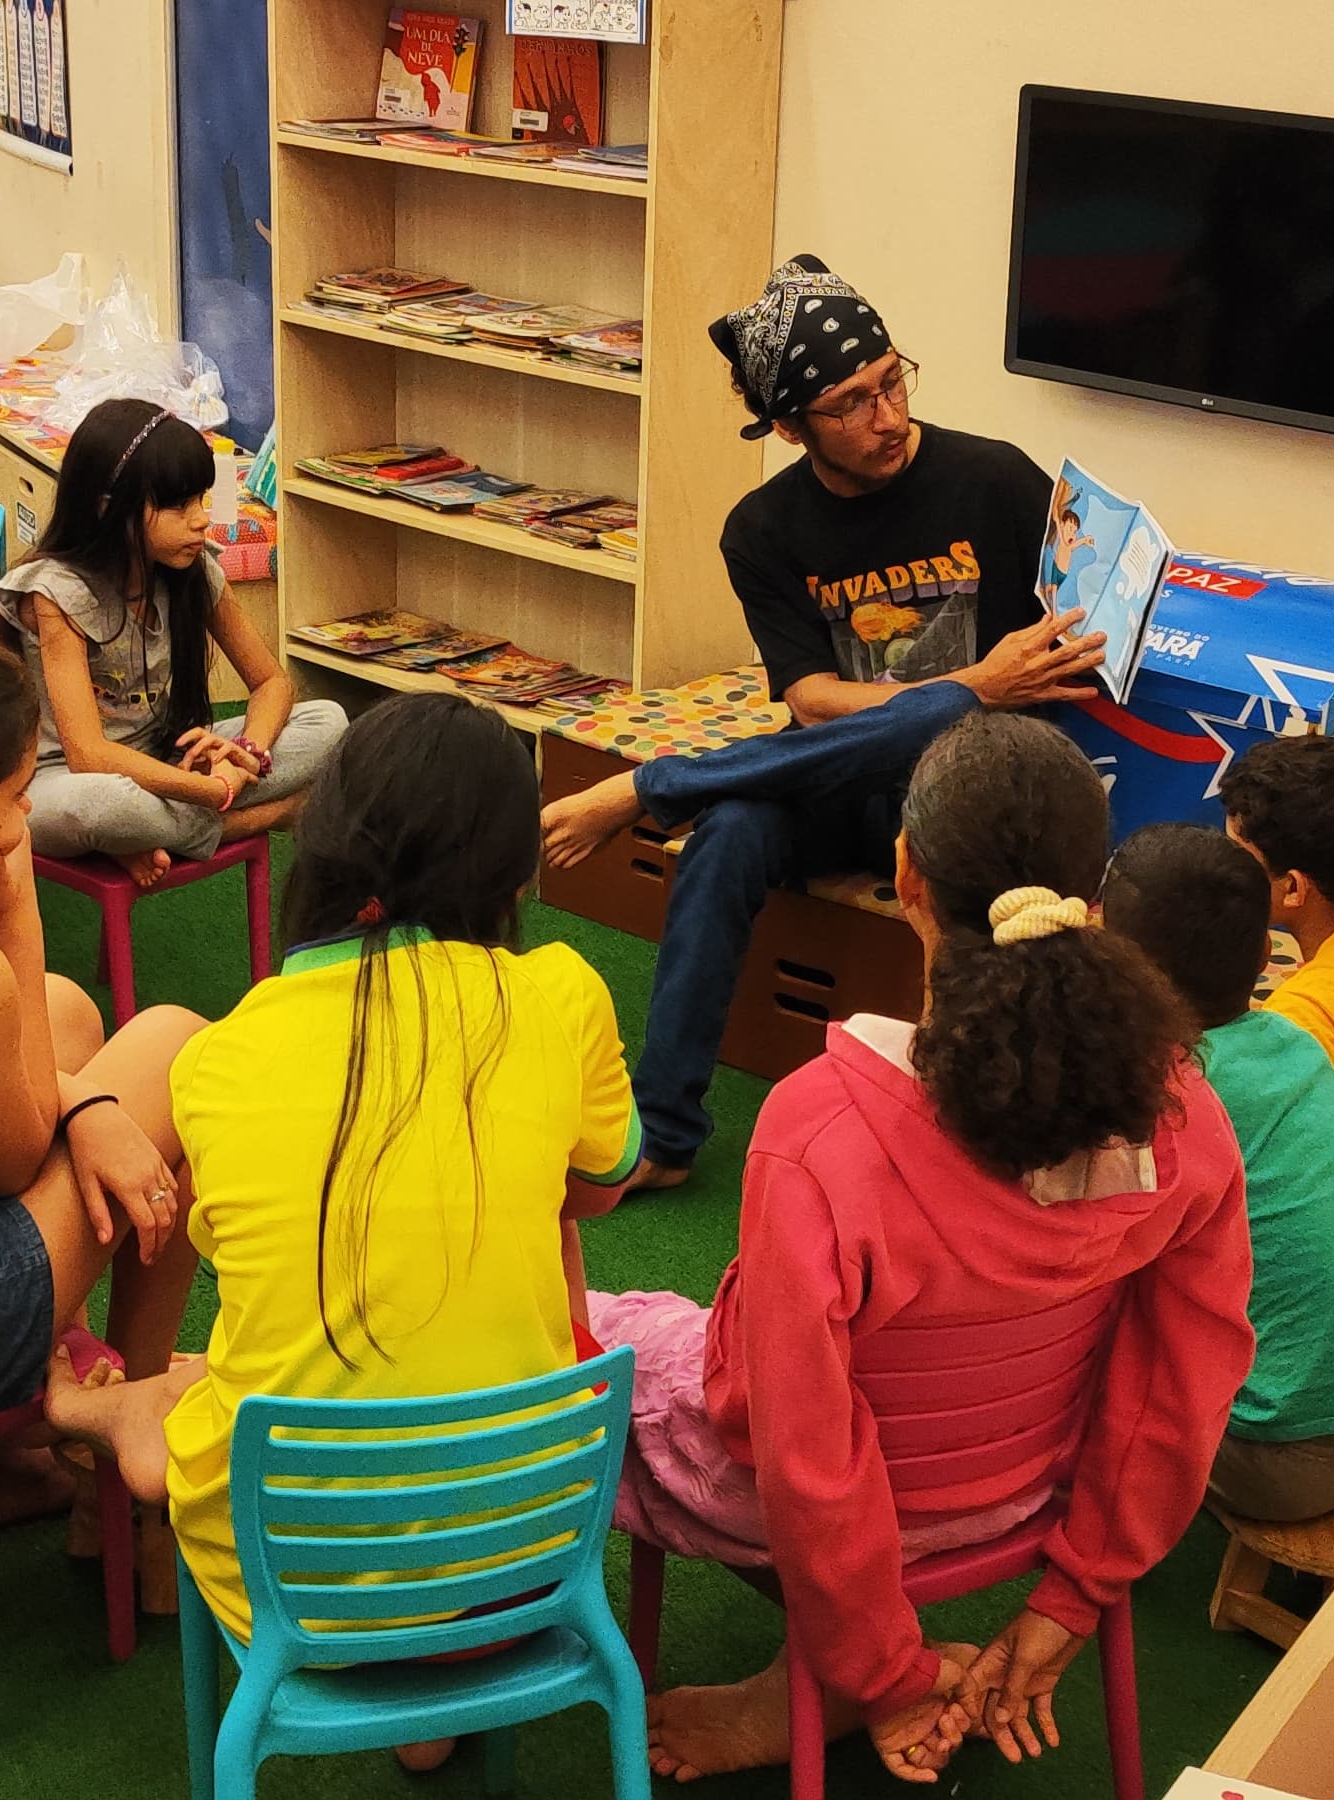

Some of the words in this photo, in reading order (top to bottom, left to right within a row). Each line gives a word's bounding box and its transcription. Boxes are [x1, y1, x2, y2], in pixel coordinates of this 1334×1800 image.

[407, 51, 444, 67] NEVE
[805, 540, 981, 610] INVADERS
[1166, 567, 1243, 593] PAZ
[1149, 623, 1191, 637] OVERNO
